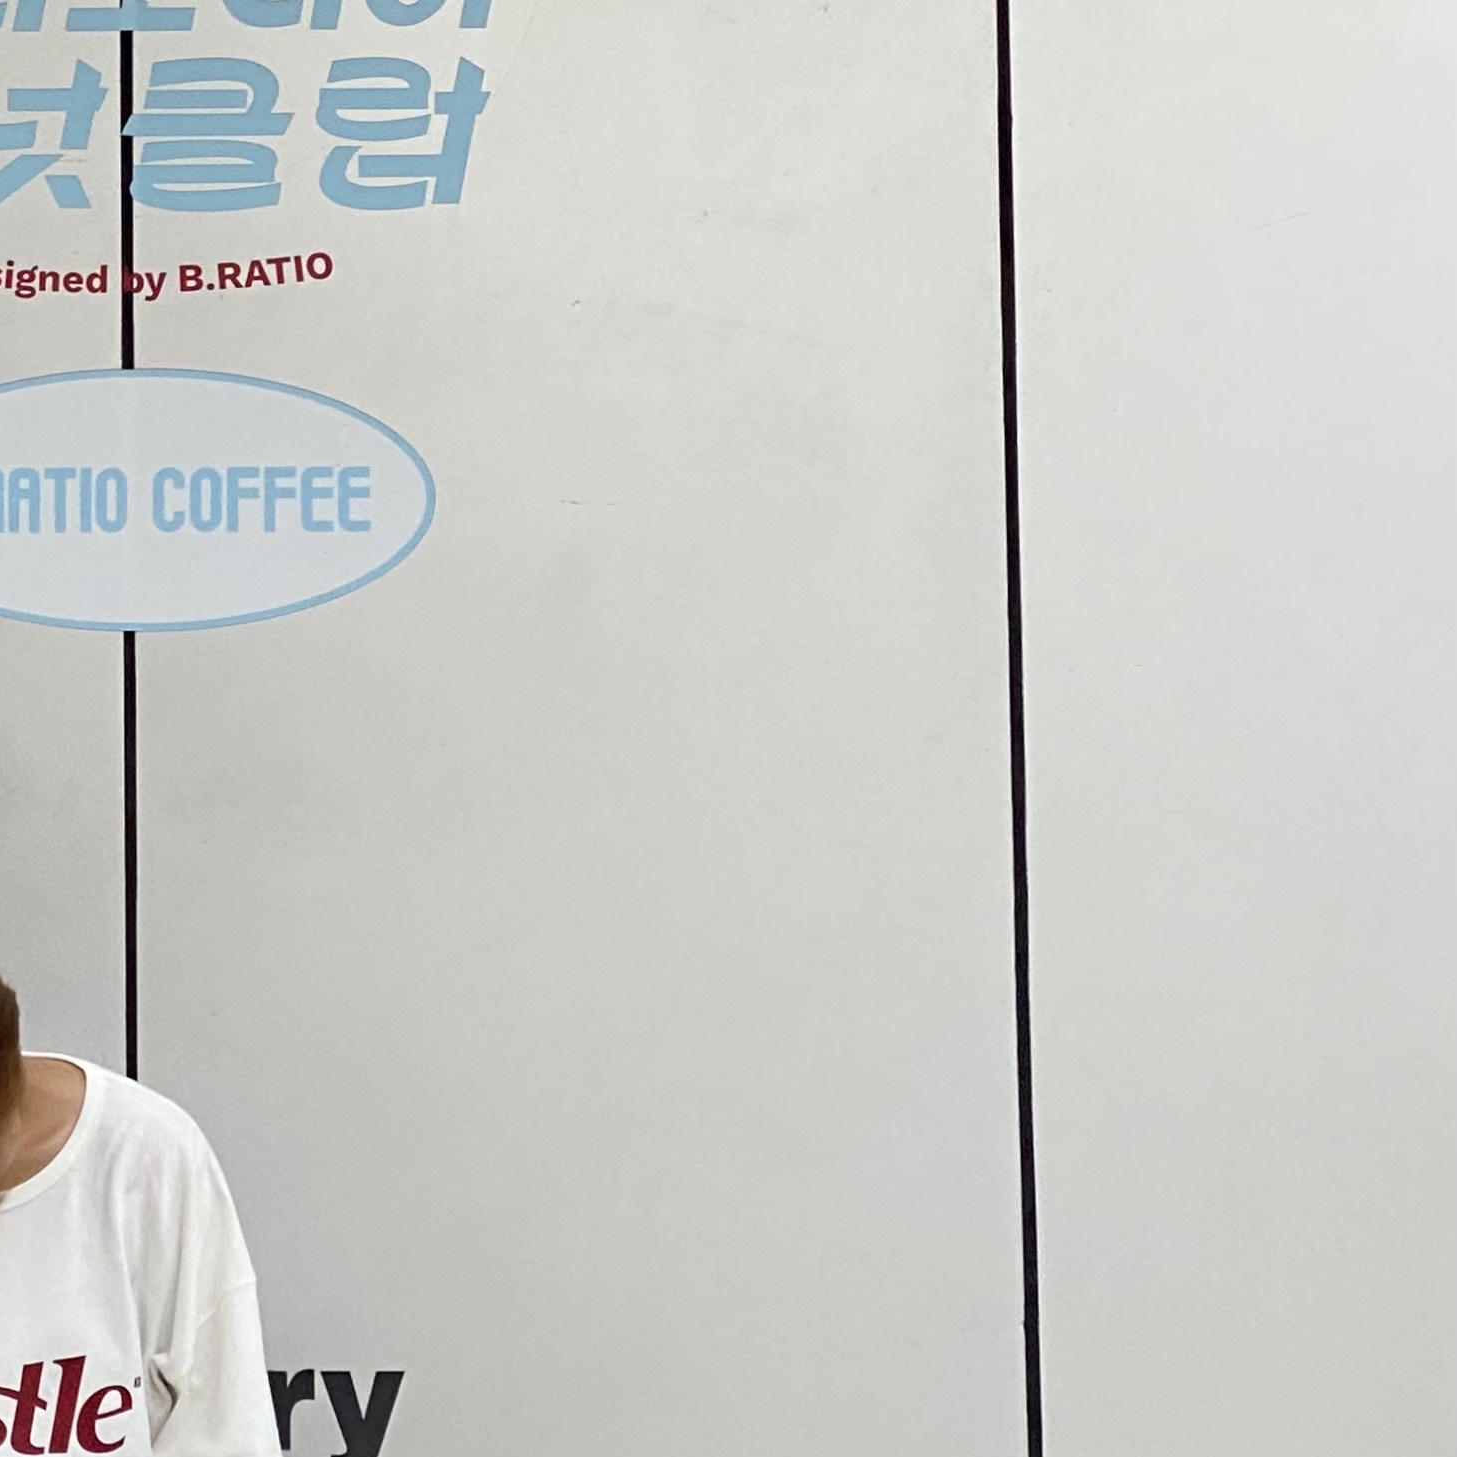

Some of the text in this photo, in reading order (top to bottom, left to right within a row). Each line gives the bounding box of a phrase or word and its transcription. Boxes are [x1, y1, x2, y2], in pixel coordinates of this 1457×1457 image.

[121, 266, 168, 301] by
[179, 252, 334, 293] B.RATIO
[152, 466, 372, 533] COFFEE
